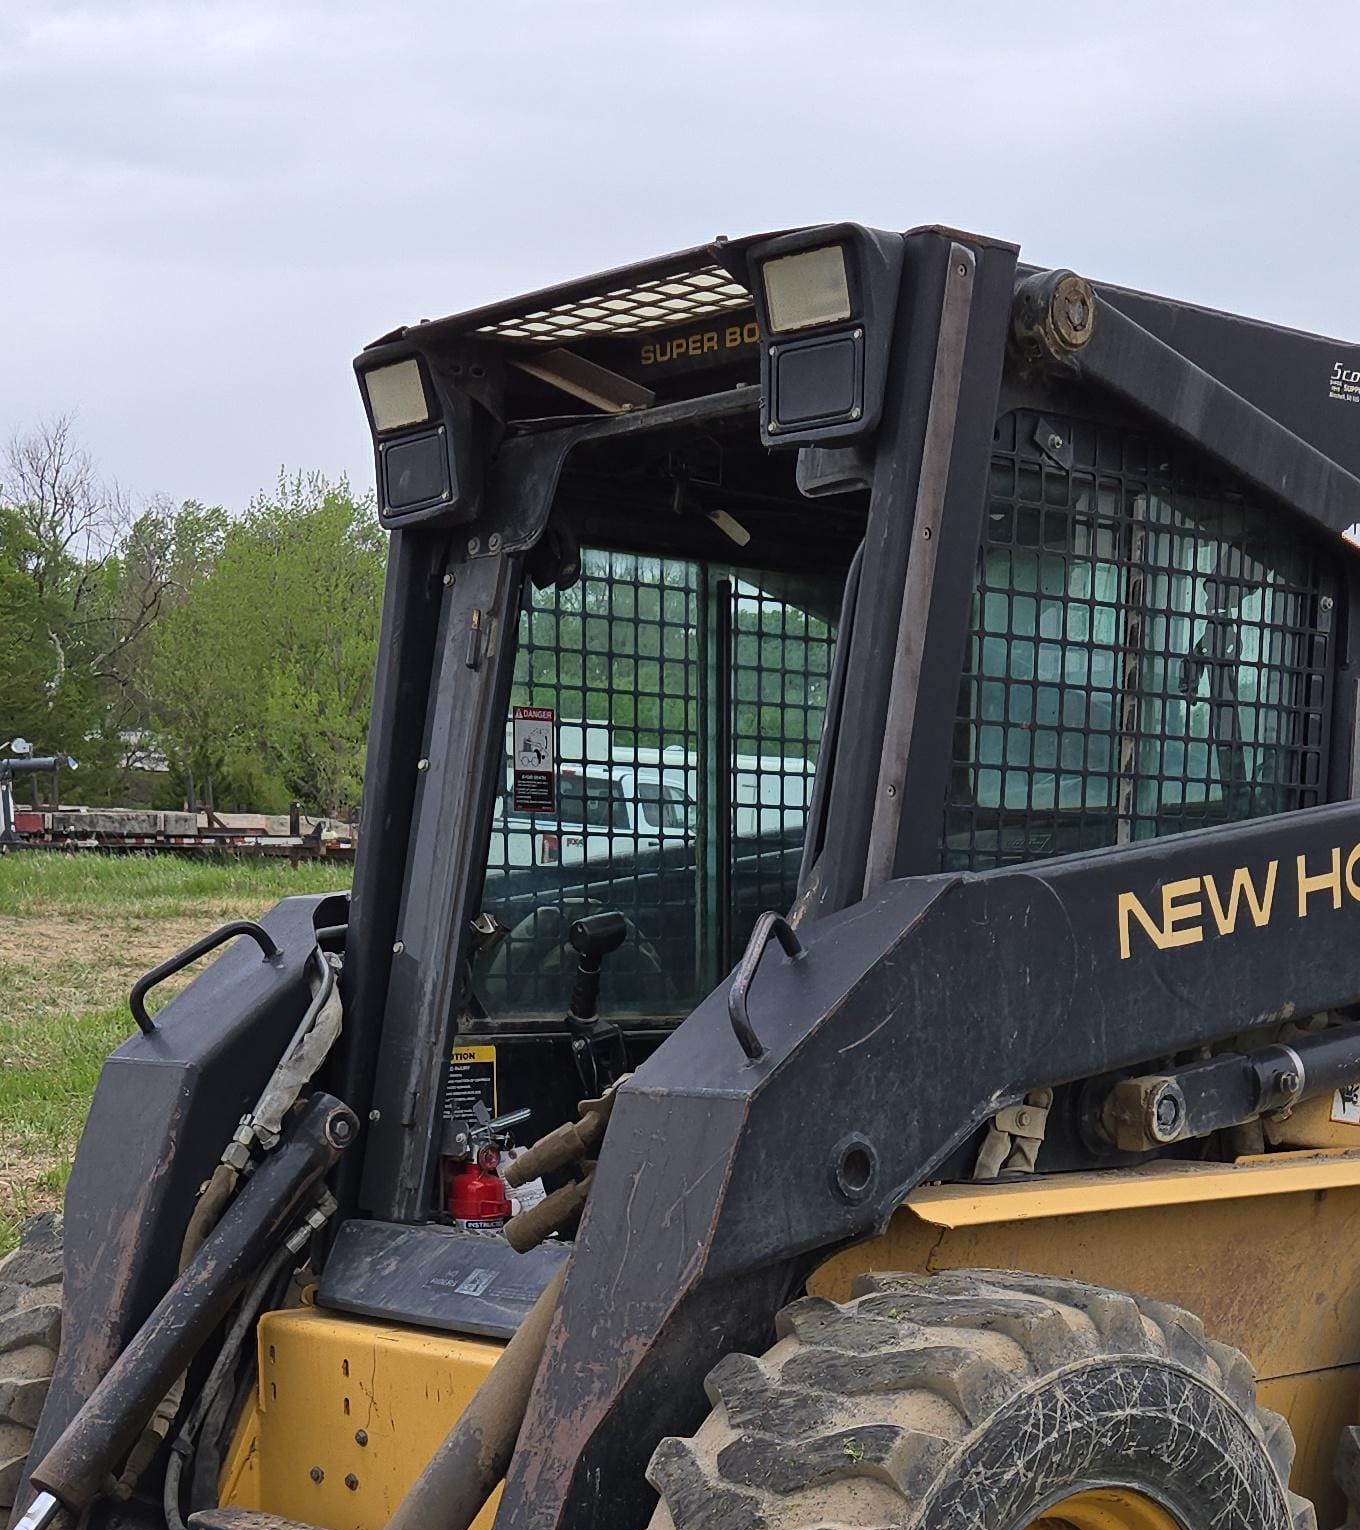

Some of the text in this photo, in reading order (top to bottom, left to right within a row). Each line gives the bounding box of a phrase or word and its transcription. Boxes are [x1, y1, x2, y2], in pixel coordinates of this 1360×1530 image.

[641, 331, 718, 364] SUPER
[523, 710, 552, 720] DANGER
[1118, 860, 1278, 960] NEW
[455, 1052, 476, 1060] TION
